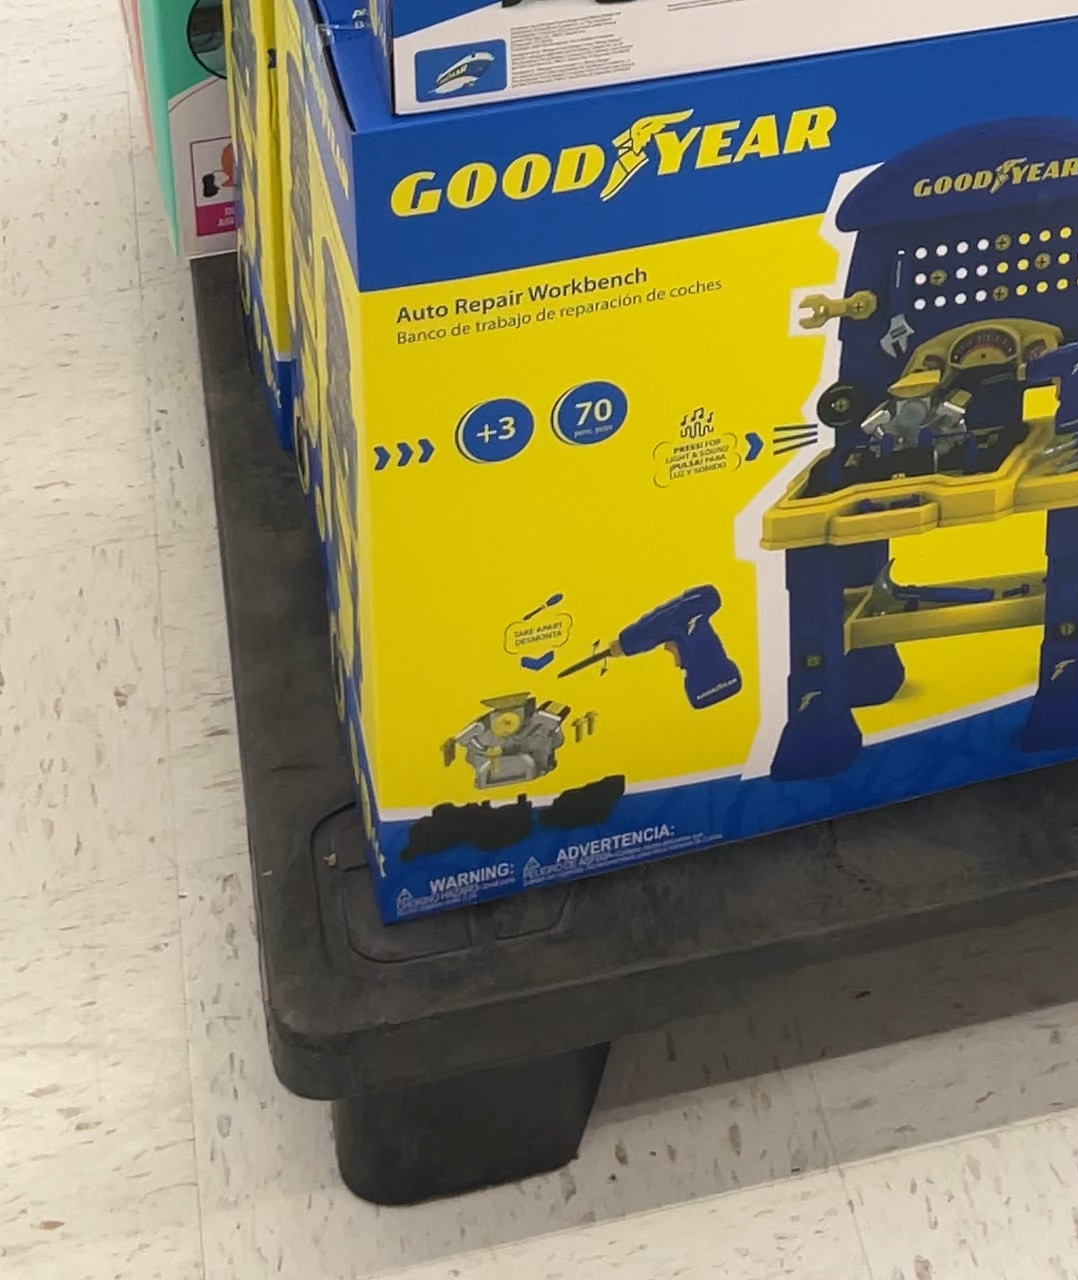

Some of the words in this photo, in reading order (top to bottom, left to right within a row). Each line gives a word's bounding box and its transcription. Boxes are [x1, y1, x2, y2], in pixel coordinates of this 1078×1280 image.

[390, 105, 838, 218] GOODYEAR
[396, 302, 449, 324] Auto
[455, 289, 523, 322] Repair
[528, 268, 648, 302] Workbench
[396, 326, 447, 346] Banco
[451, 319, 472, 338] de
[475, 308, 533, 335] trabajo
[536, 305, 557, 324] de
[560, 292, 643, 324] reparación
[647, 285, 667, 304] de
[670, 277, 723, 299] coches
[476, 416, 516, 444] +3
[575, 398, 613, 426] 70
[556, 824, 676, 864] ADVERTENCIA:
[429, 862, 515, 895] WARNING:
